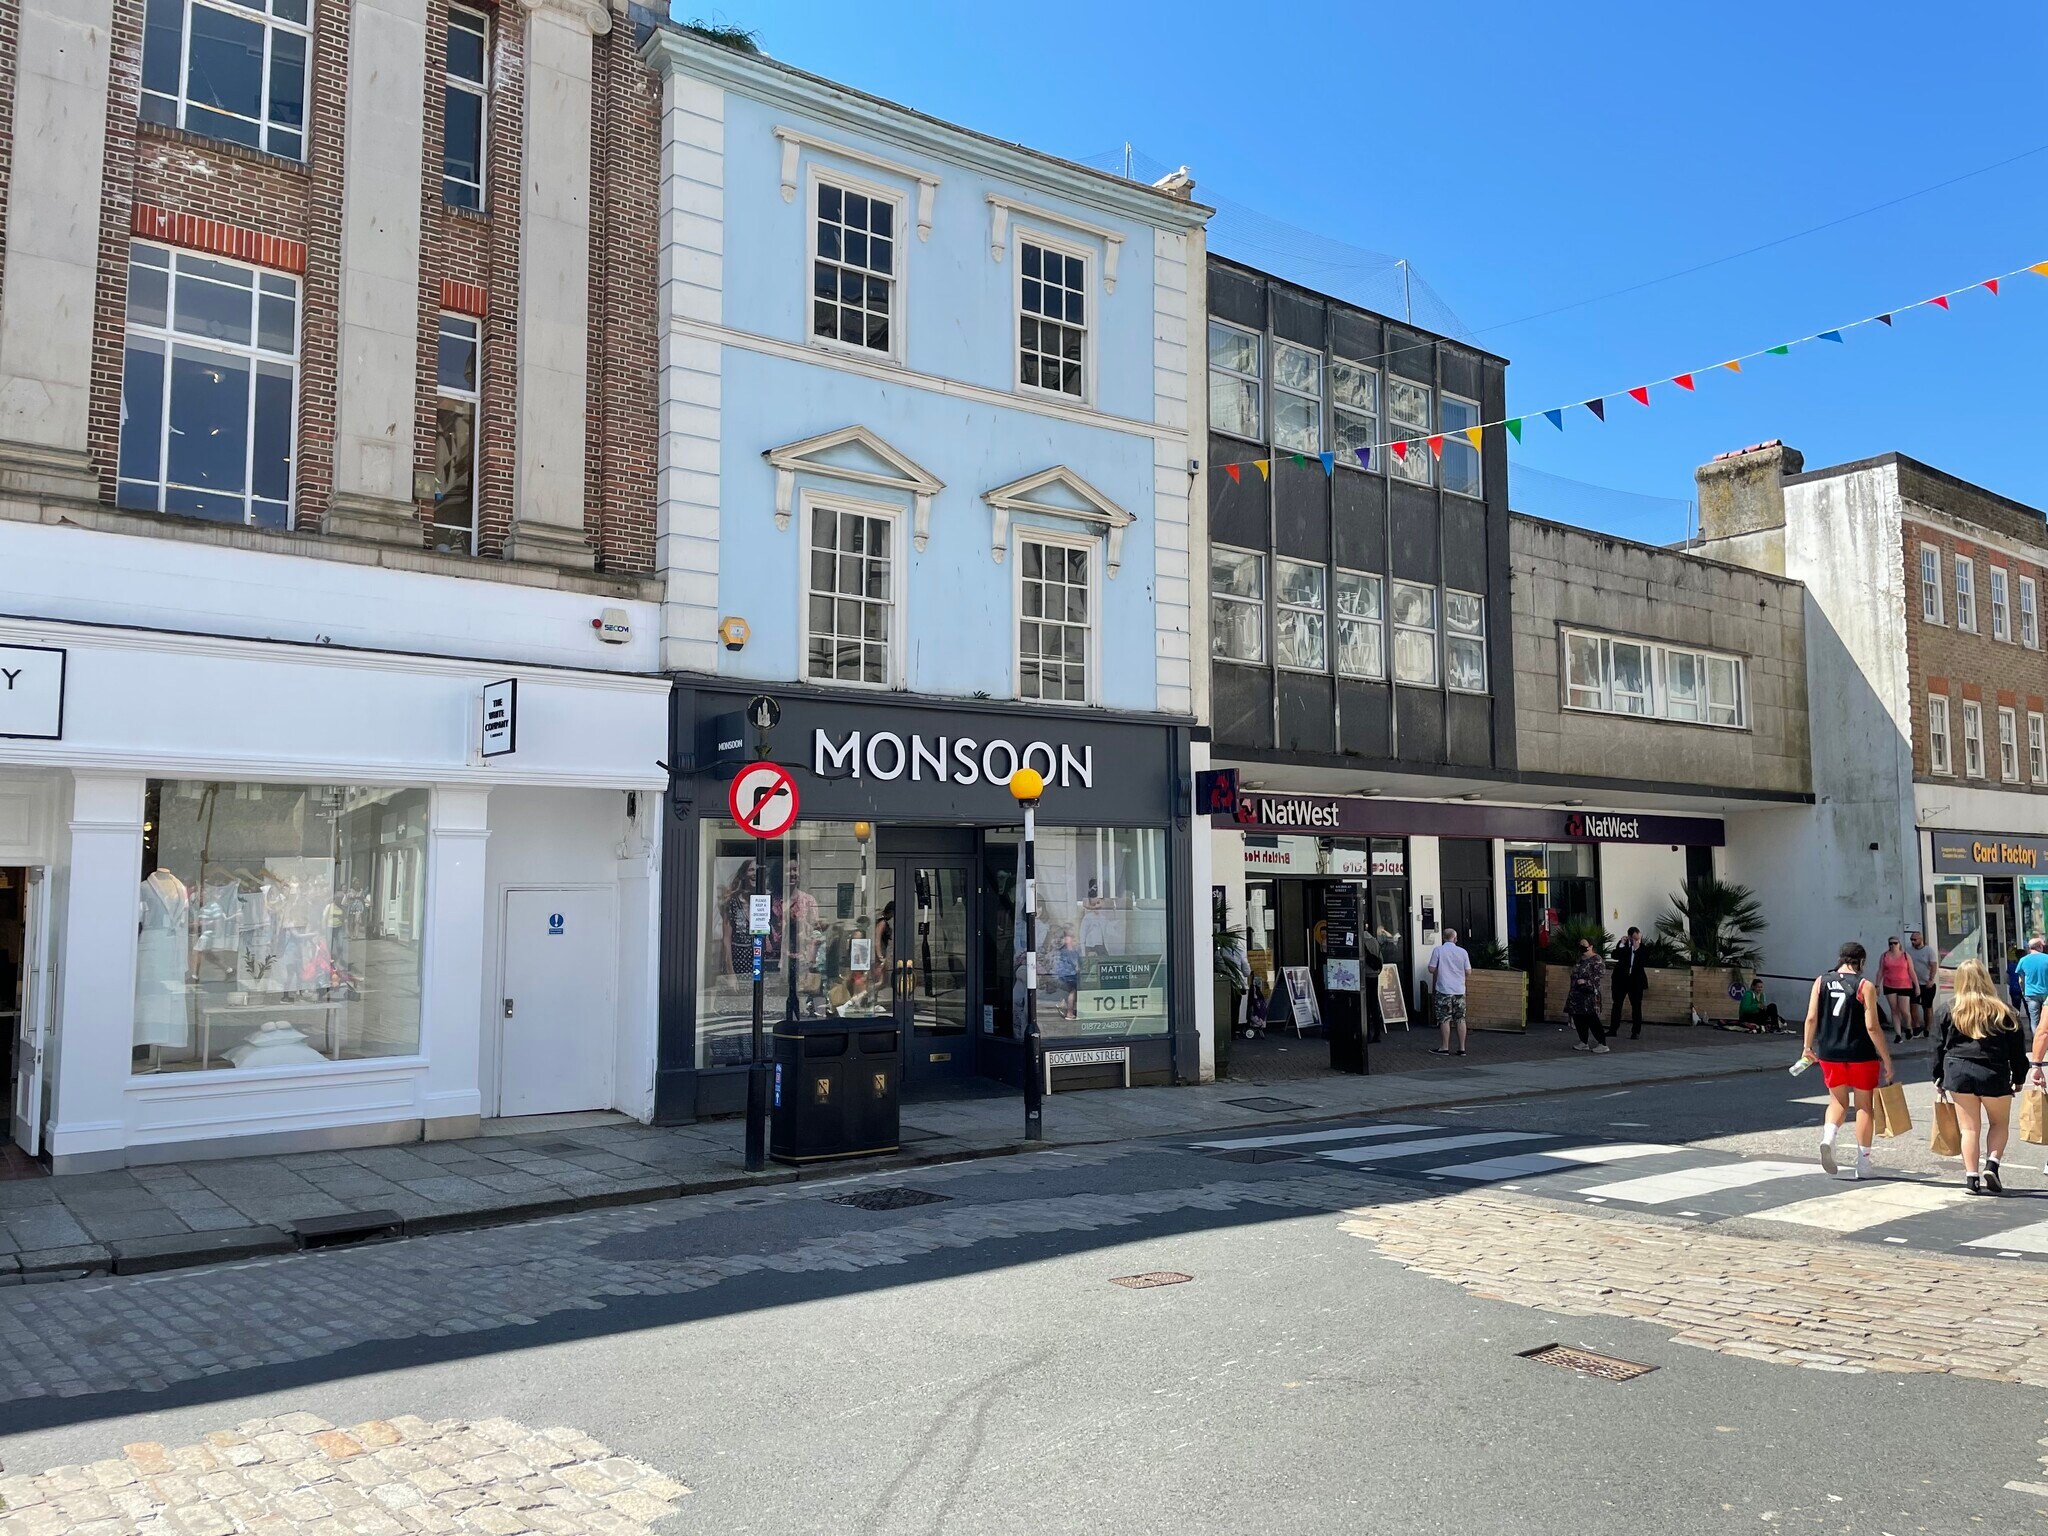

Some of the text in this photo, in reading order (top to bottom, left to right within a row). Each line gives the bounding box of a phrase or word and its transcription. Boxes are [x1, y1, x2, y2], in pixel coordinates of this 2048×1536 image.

[604, 624, 630, 634] SECOM
[492, 698, 503, 708] THE
[484, 719, 509, 732] COMPANY
[718, 739, 743, 752] MONSOON
[815, 728, 1093, 788] MONSOON
[1262, 799, 1340, 827] NatWest
[1586, 815, 1640, 838] NatWest
[1973, 841, 1999, 863] Card
[2000, 843, 2037, 869] Factory
[1125, 964, 1150, 972] GUNN
[1093, 995, 1148, 1011] TO LET
[1830, 991, 1846, 1017] 7
[1081, 1022, 1101, 1031] 01872
[1050, 1050, 1124, 1064] BOSCAWEN STREET
